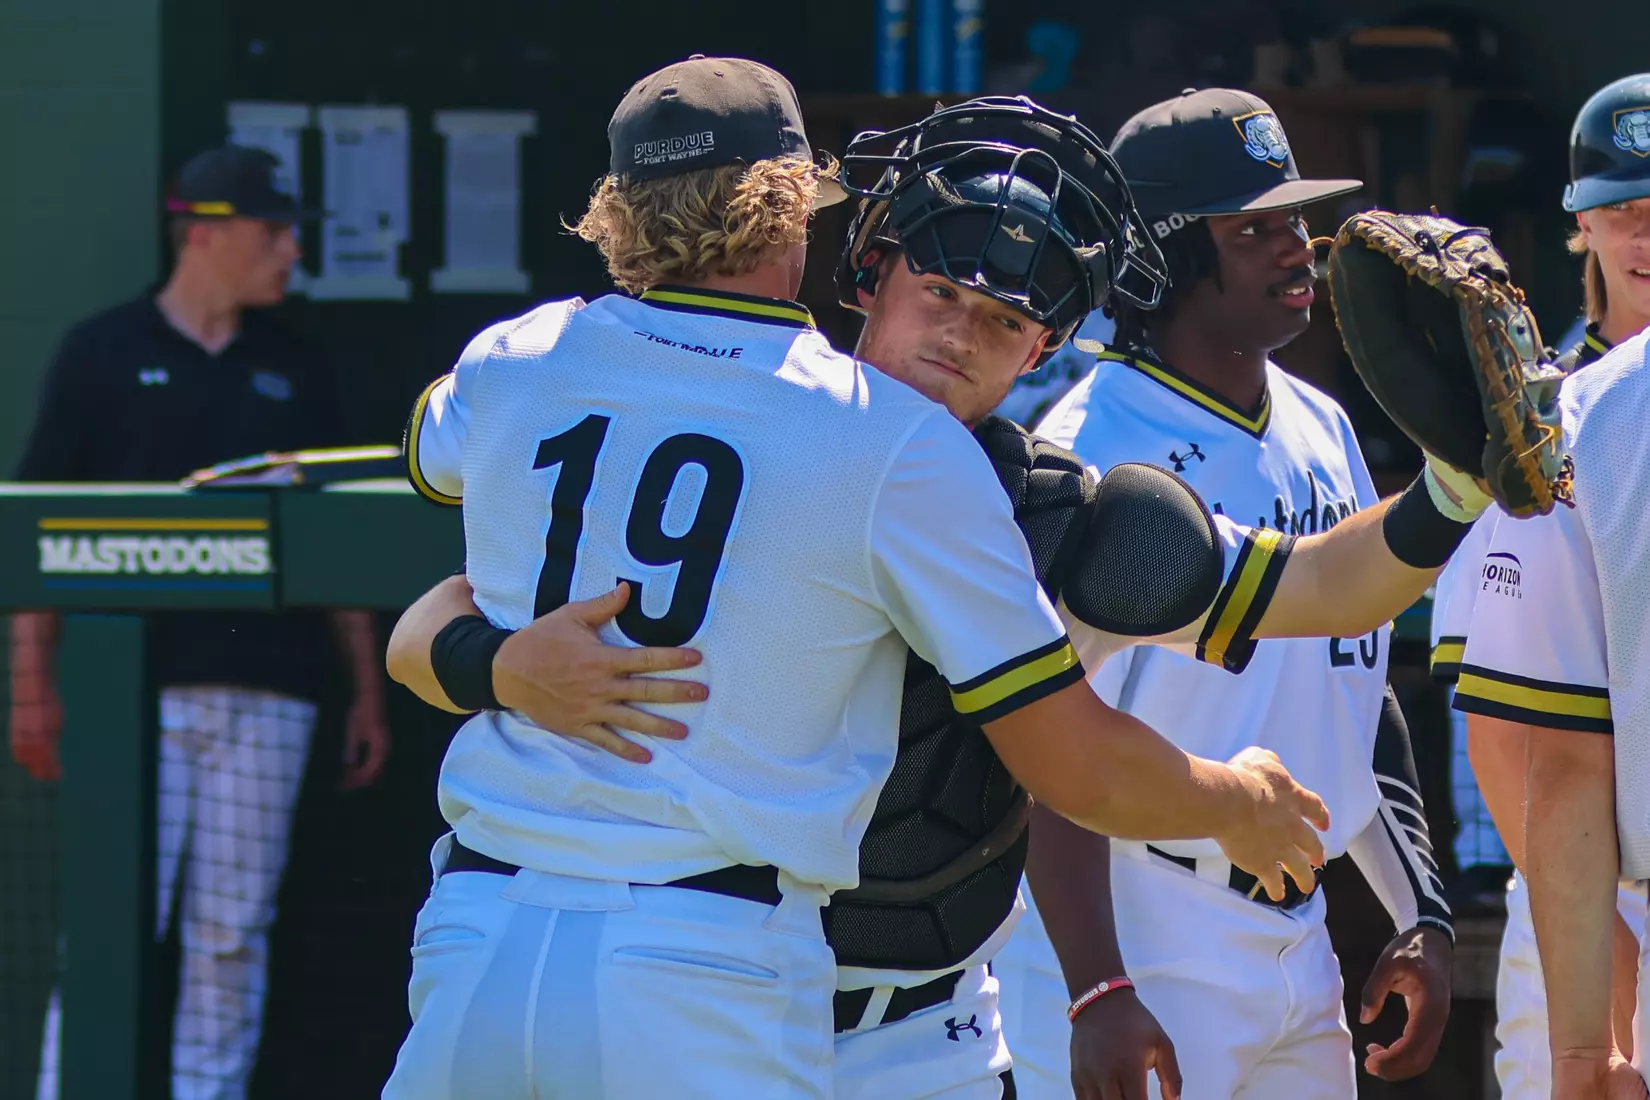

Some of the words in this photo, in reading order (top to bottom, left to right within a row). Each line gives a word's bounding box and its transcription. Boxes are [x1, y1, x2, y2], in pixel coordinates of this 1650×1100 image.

[634, 131, 715, 159] PURDUE
[643, 155, 667, 165] FORT
[668, 148, 703, 162] WAYNE
[532, 413, 745, 648] 19
[39, 536, 271, 574] MASTODONS
